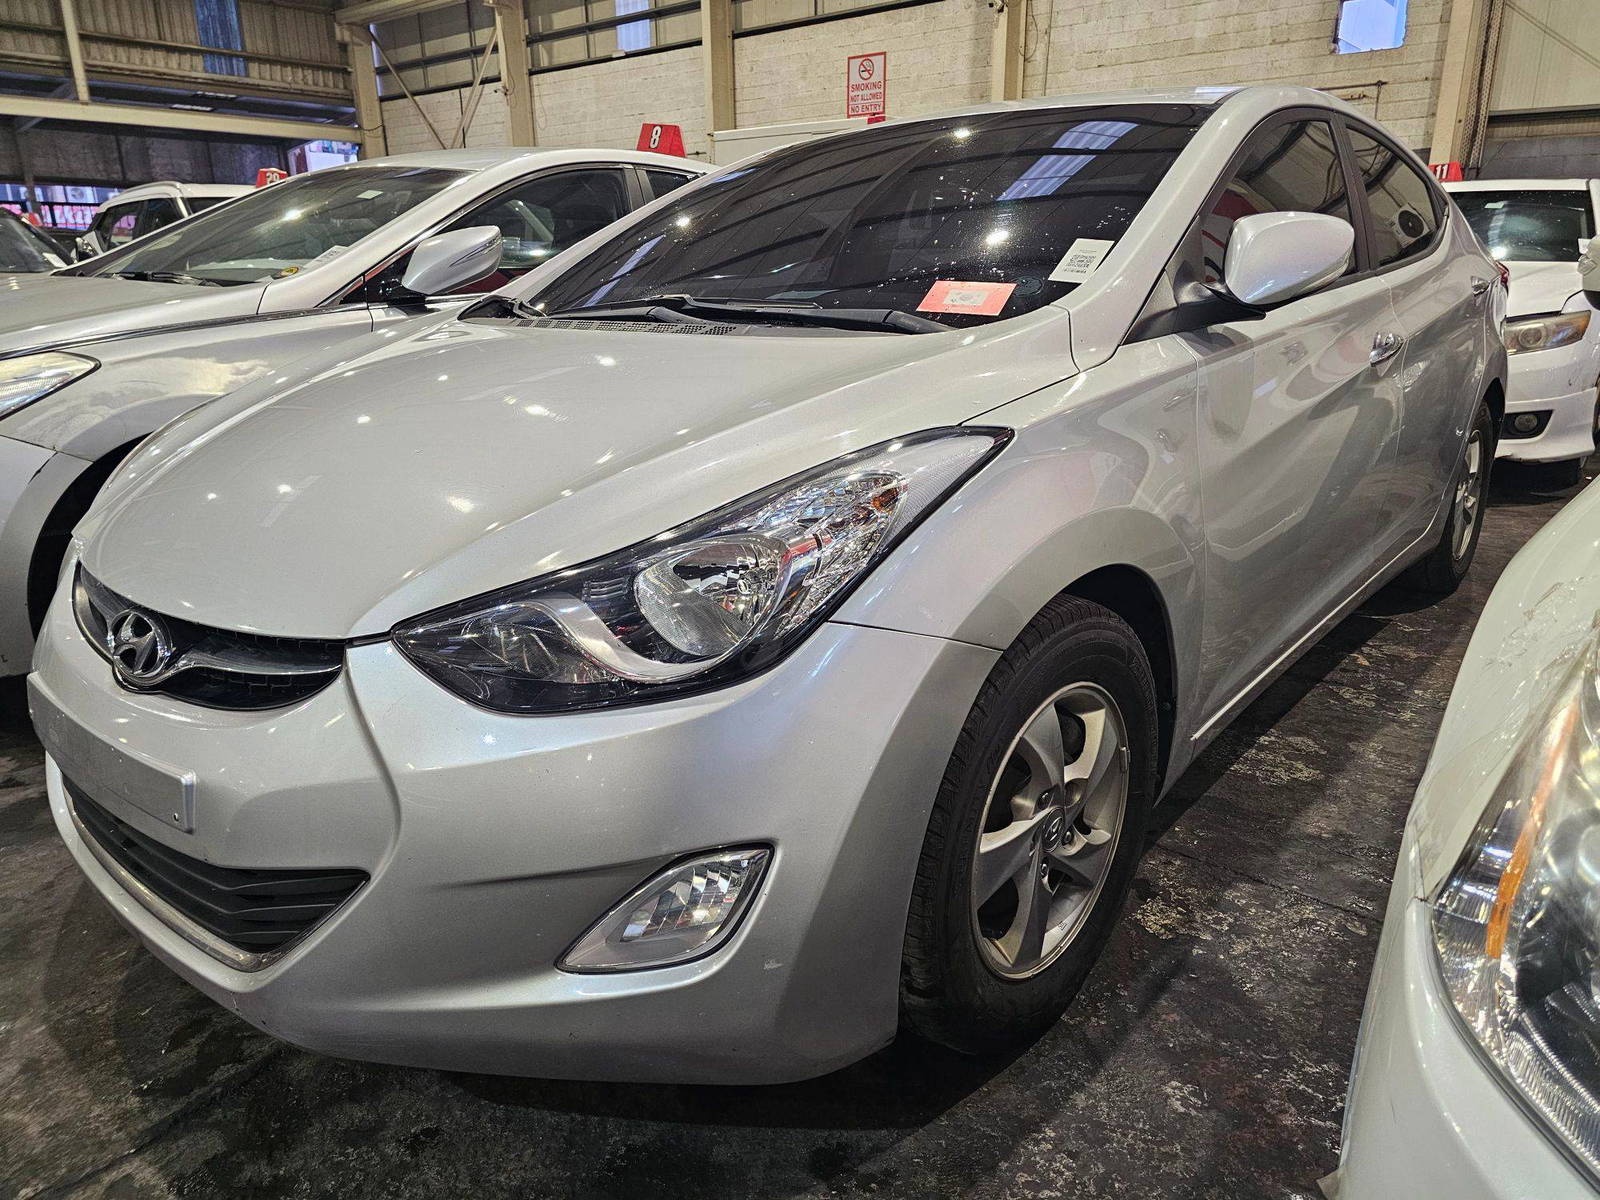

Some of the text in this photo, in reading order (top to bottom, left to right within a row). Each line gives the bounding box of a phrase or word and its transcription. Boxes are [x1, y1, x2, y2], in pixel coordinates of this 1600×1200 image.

[851, 81, 882, 92] SMOKING
[861, 92, 882, 101] ALLOWED
[851, 103, 881, 113] NO ENTRY
[649, 125, 662, 149] 8
[1435, 164, 1449, 180] 11
